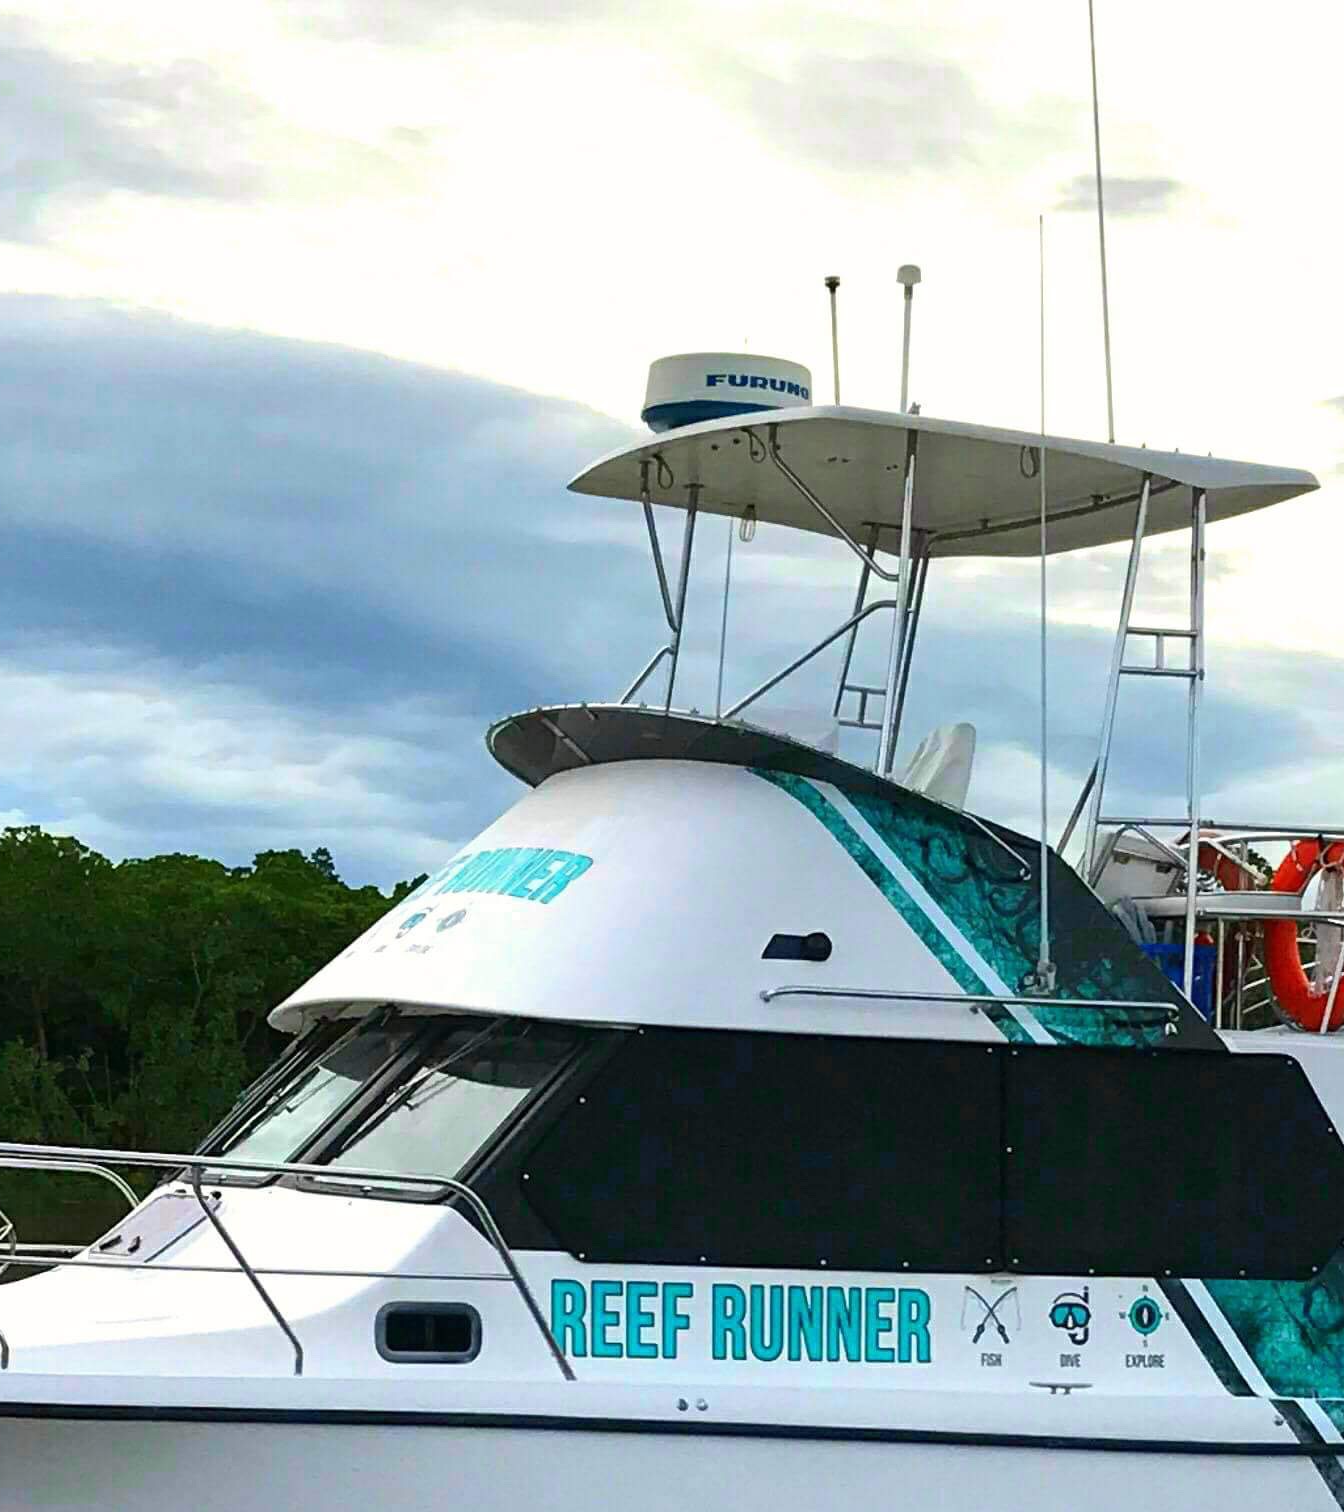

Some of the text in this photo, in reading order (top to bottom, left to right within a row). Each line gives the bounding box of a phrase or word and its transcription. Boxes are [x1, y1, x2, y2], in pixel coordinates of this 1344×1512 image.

[706, 373, 809, 400] FURUNO
[551, 1278, 932, 1364] REEF RUNNER
[980, 1353, 1003, 1367] FISH
[1060, 1353, 1081, 1368] DIVE
[1125, 1354, 1166, 1369] EXPLORE
